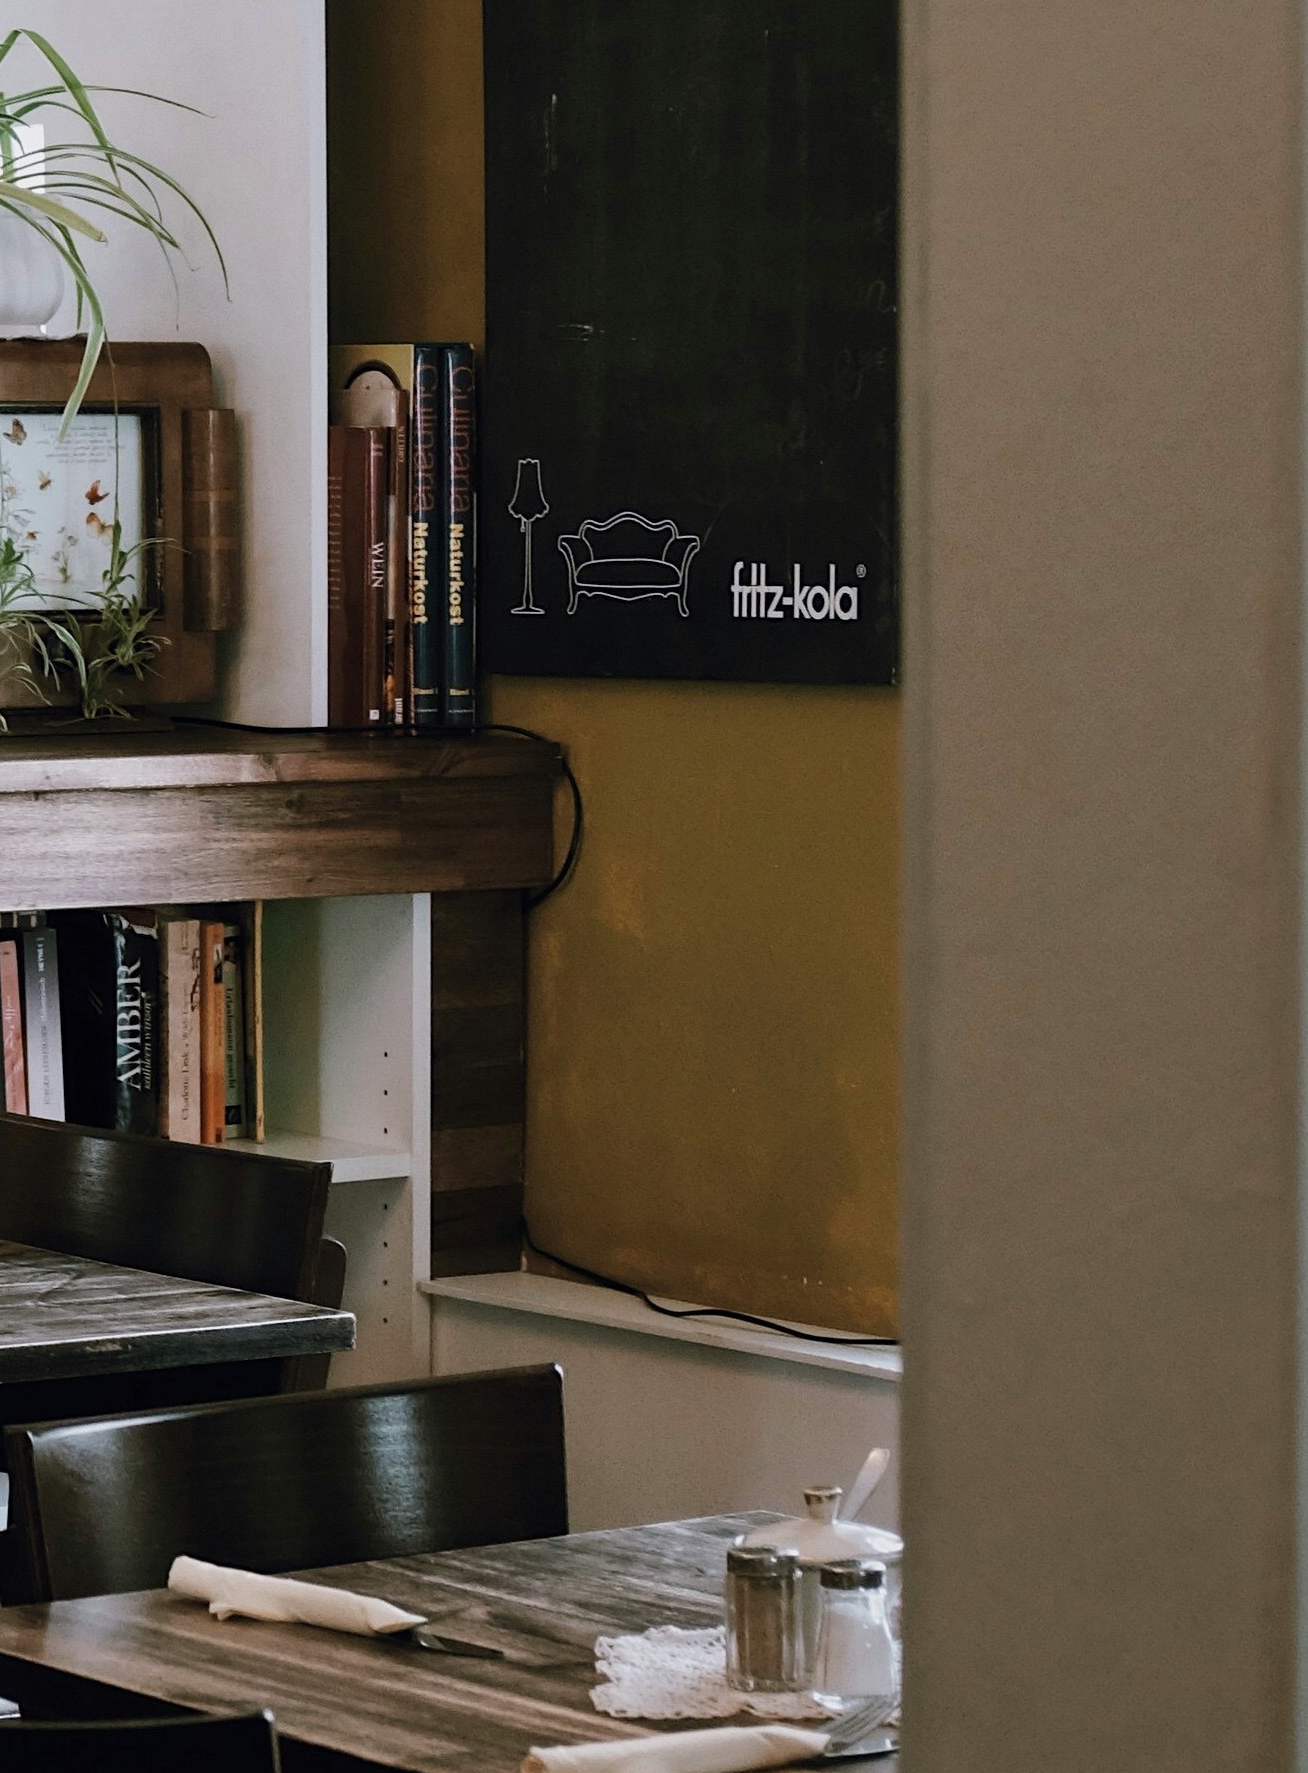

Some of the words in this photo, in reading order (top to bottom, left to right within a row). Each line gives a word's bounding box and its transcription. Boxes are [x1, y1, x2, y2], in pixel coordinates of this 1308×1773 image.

[413, 365, 438, 513] Culinaria
[450, 366, 475, 513] Culinaria
[371, 541, 384, 588] WEIN
[413, 522, 429, 625] Naturkost
[450, 522, 465, 626] Naturkost
[731, 561, 858, 620] fritz-kola
[117, 958, 141, 1090] AMBER
